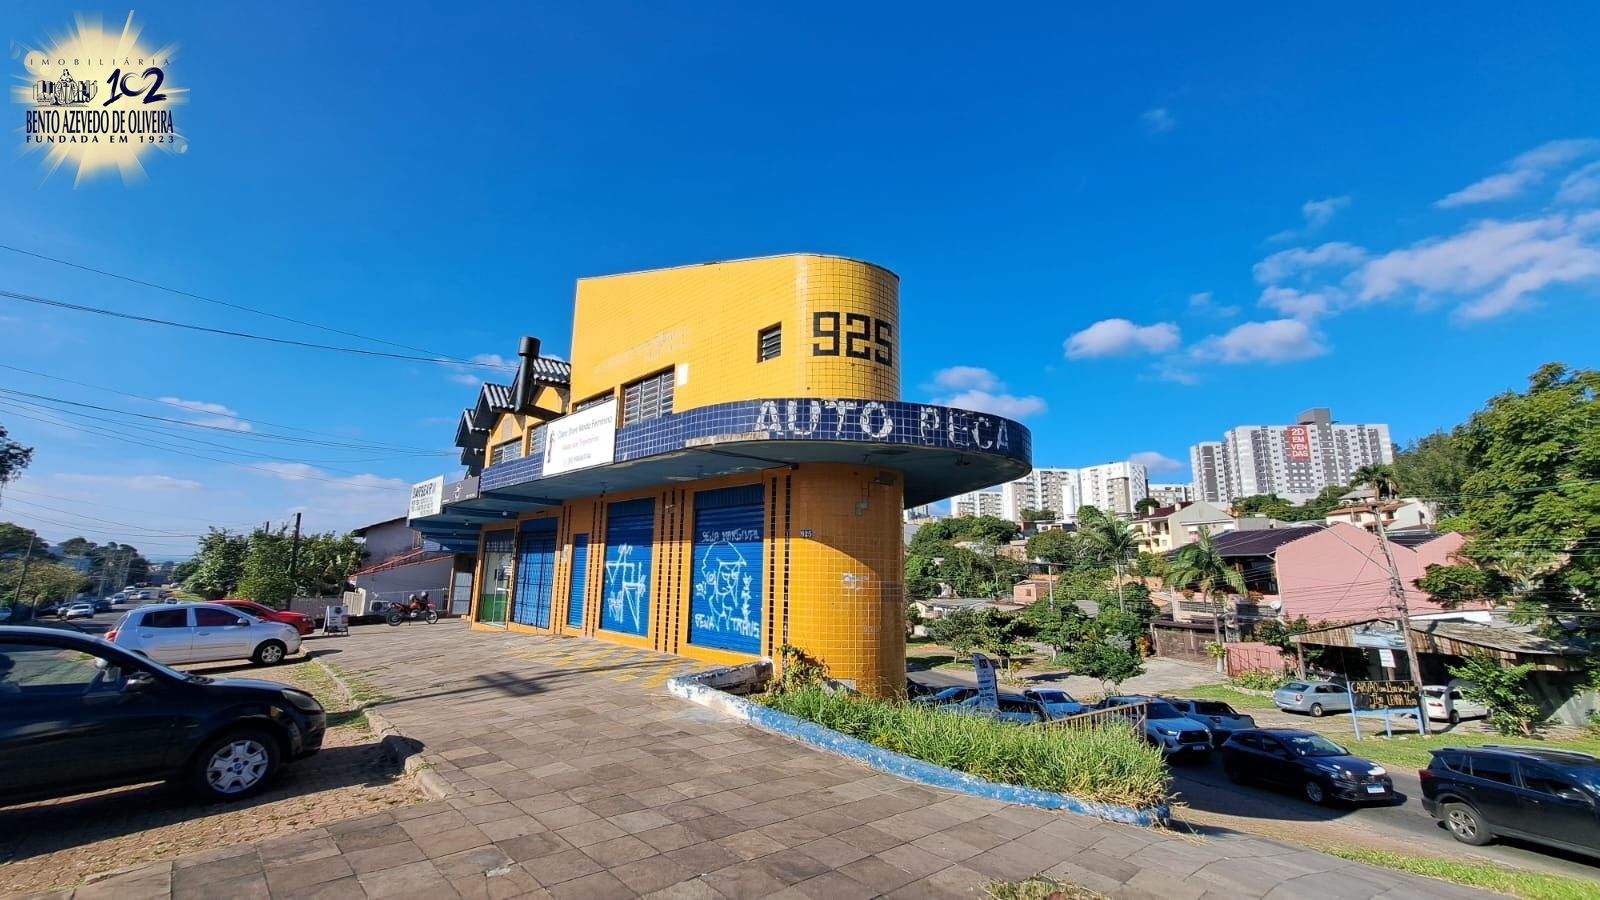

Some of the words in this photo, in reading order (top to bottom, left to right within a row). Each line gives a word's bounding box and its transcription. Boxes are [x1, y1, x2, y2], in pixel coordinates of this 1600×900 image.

[812, 311, 893, 366] 925
[756, 400, 894, 439] AUTO
[1291, 427, 1305, 436] 2D
[801, 529, 812, 538] 925
